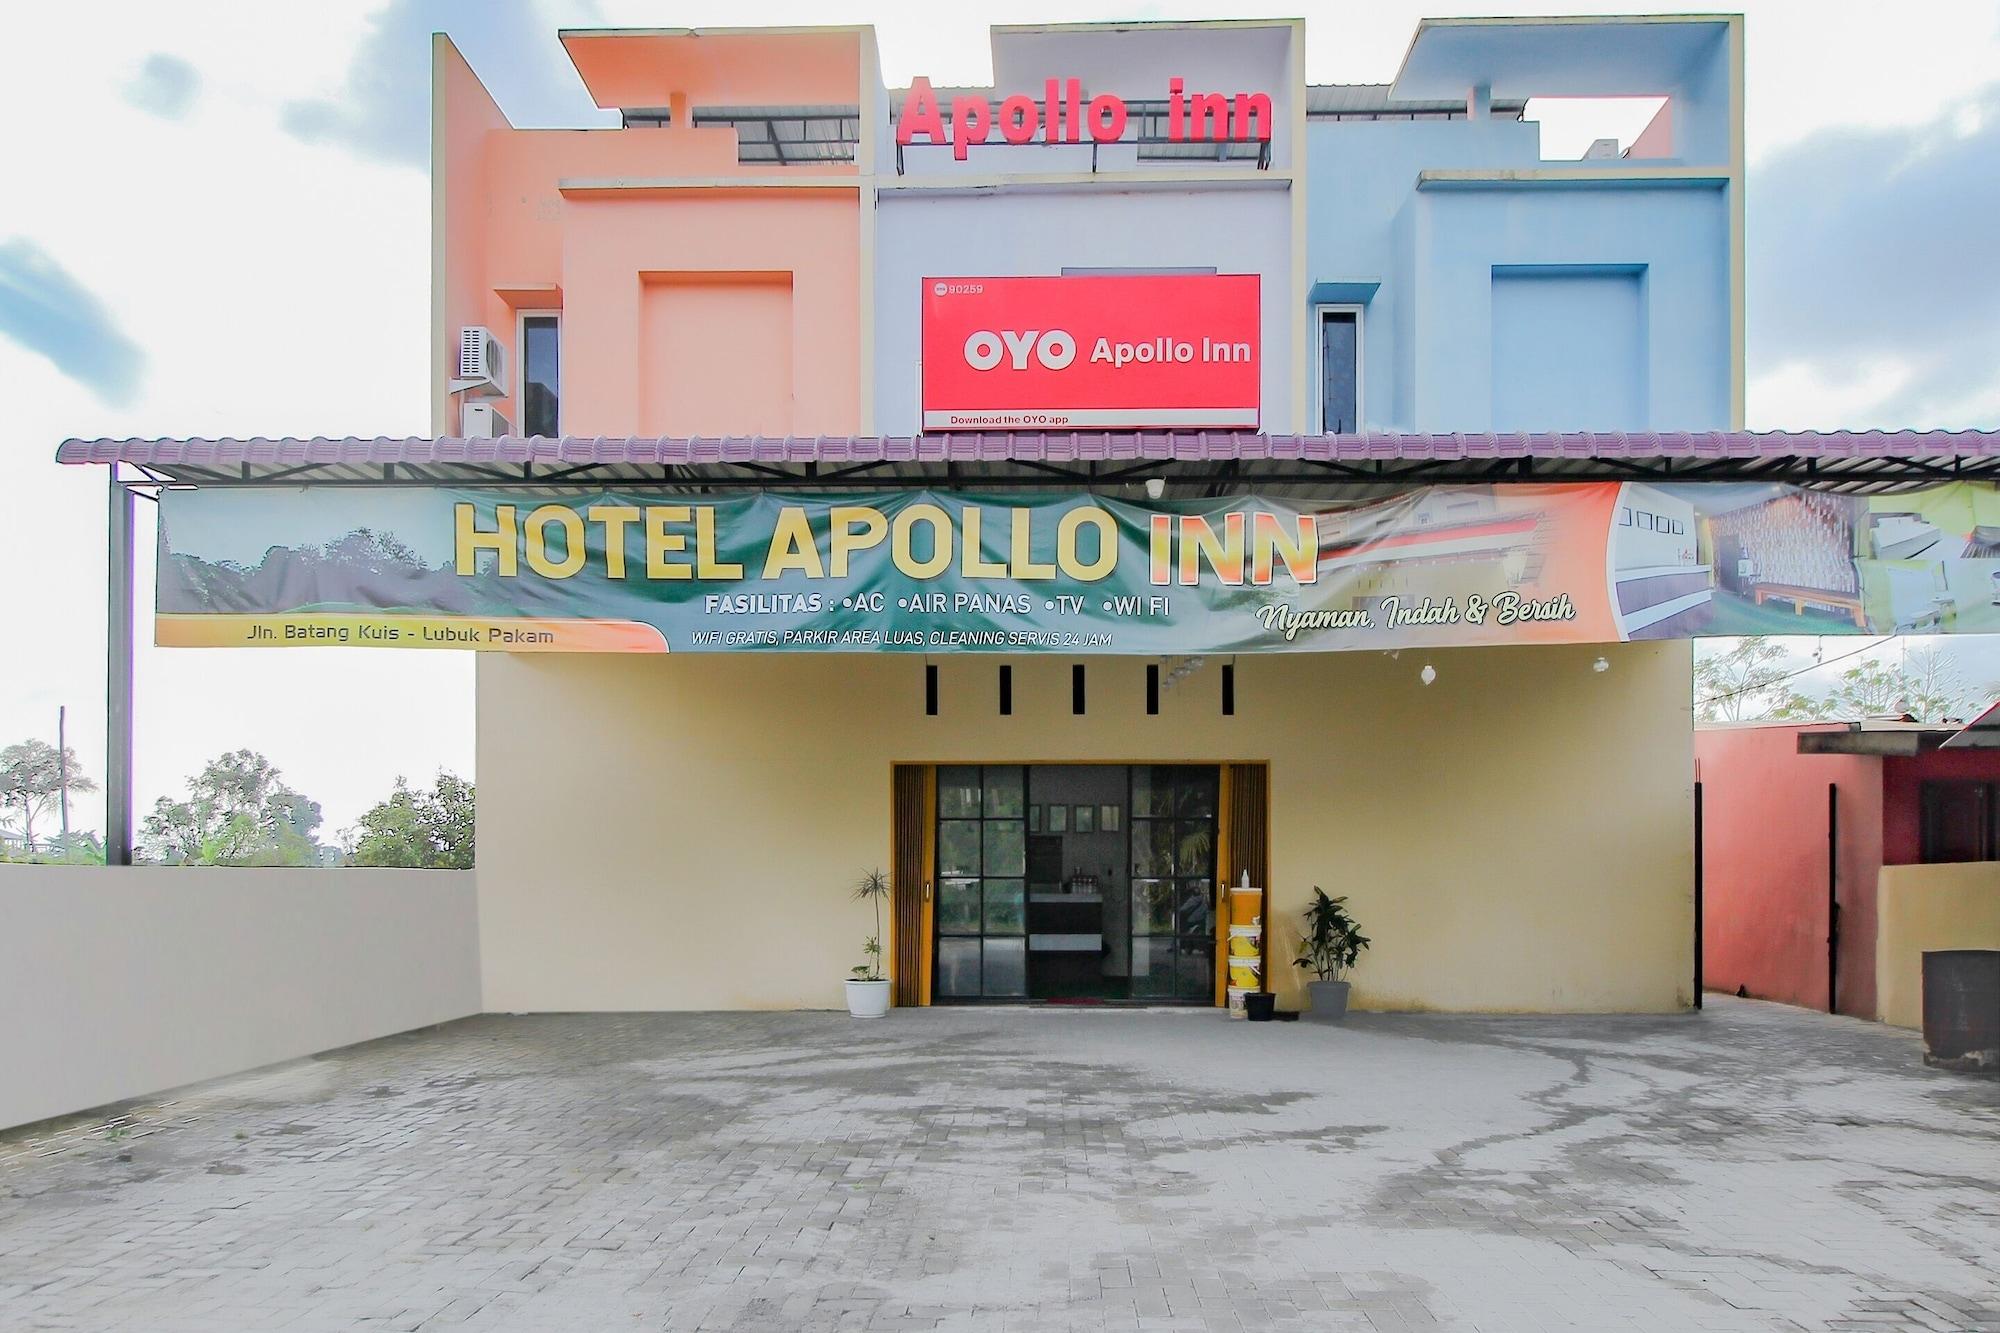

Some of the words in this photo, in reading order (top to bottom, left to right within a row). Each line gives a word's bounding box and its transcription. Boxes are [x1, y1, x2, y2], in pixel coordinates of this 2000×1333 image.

[897, 76, 1127, 160] Apollo
[1169, 77, 1271, 142] inn
[949, 285, 983, 294] 90259
[963, 329, 1077, 371] OYO
[1090, 337, 1194, 368] Apollo
[1202, 337, 1251, 362] Inn
[950, 416, 1002, 424] Download
[1004, 416, 1020, 424] the
[1023, 415, 1047, 424] OYO
[1049, 416, 1069, 425] app
[455, 503, 744, 580] HOTEL
[761, 503, 1119, 581] APOLLO
[1149, 512, 1319, 586] INN
[705, 593, 822, 614] FASILITAS
[953, 593, 1031, 613] PANAS
[1149, 597, 1170, 616] FI
[1255, 603, 1375, 641] Nyaman,
[1380, 595, 1460, 629] Indah
[1464, 593, 1489, 625] &
[1490, 591, 1576, 624] Bersih
[247, 624, 277, 640] Jln.
[284, 624, 349, 641] Batang
[358, 625, 400, 640] Kuis
[423, 626, 480, 642] Lubuk
[488, 627, 555, 643] Pakam
[691, 631, 722, 644] WIFI
[725, 631, 779, 645] GRATIS,
[783, 630, 839, 644] PARKIR
[840, 630, 884, 644] AREA
[884, 631, 926, 646] LUAS,
[929, 631, 1005, 645] CLEANING
[1007, 631, 1060, 646] SERVIS
[1062, 633, 1080, 646] 24
[1083, 633, 1113, 646] JAM
